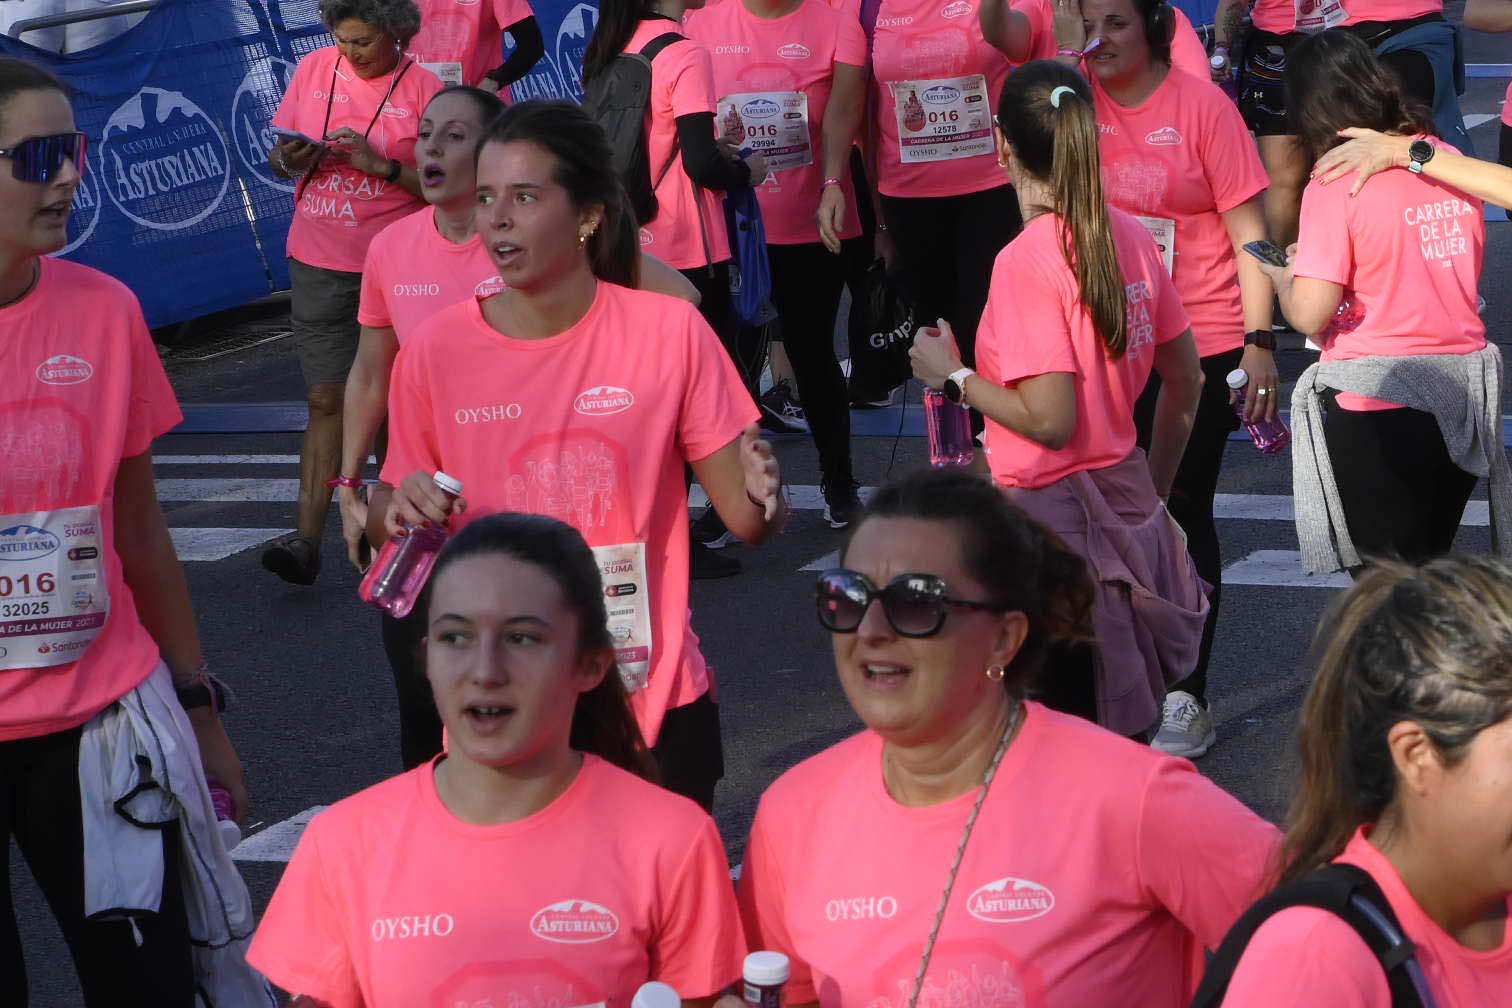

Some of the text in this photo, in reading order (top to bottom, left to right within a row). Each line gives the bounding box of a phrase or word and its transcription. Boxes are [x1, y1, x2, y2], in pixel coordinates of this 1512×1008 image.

[312, 91, 349, 104] OYHO
[925, 92, 957, 102] ASTURIANA
[744, 105, 778, 115] ASTURIANA
[928, 110, 960, 124] 016
[747, 124, 778, 137] 016
[752, 139, 776, 148] 29994
[302, 194, 357, 219] SUMA
[1404, 199, 1473, 226] CARRERA
[1421, 221, 1462, 242] DE LA
[1421, 238, 1467, 261] MUJER
[393, 284, 440, 297] OYSHO
[38, 365, 91, 380] ASTURIANA
[578, 393, 632, 410] ASTURIANA
[454, 403, 522, 426] OYSHO
[65, 526, 96, 538] SUMA
[604, 564, 634, 575] SUMA
[2, 600, 50, 619] 32025
[825, 896, 898, 923] OYSHO
[973, 891, 1048, 913] ASTURIANA
[370, 913, 455, 942] OYSHO
[535, 911, 617, 937] ASTURIANA
